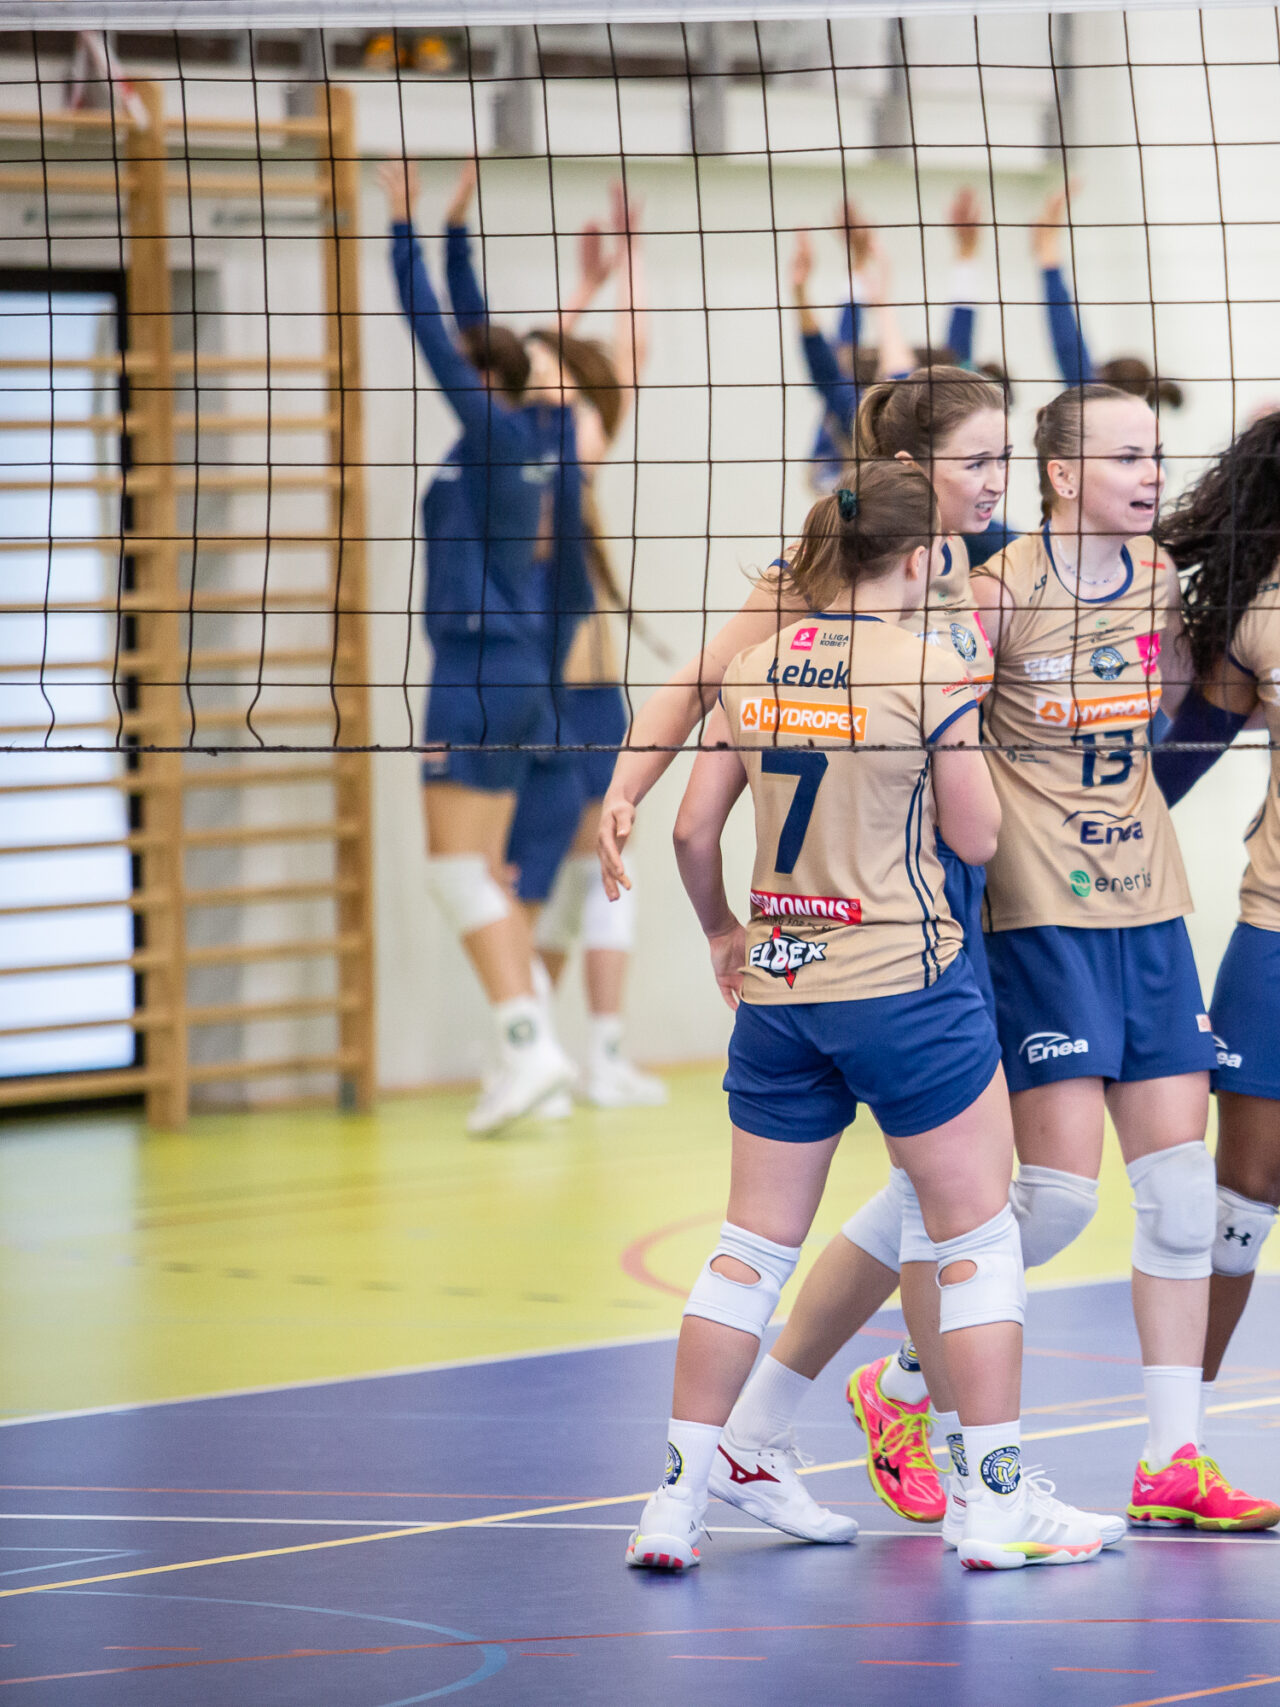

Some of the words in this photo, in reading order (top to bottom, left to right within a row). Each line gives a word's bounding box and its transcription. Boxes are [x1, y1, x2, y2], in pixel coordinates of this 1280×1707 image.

[828, 632, 849, 641] LIGA
[763, 706, 862, 733] HYDROPEX
[1071, 730, 1134, 787] 13
[761, 750, 829, 874] 7
[1095, 867, 1152, 893] eneris
[749, 938, 827, 970] ELBEX
[1027, 1039, 1089, 1064] Enea
[1216, 1051, 1243, 1068] ea
